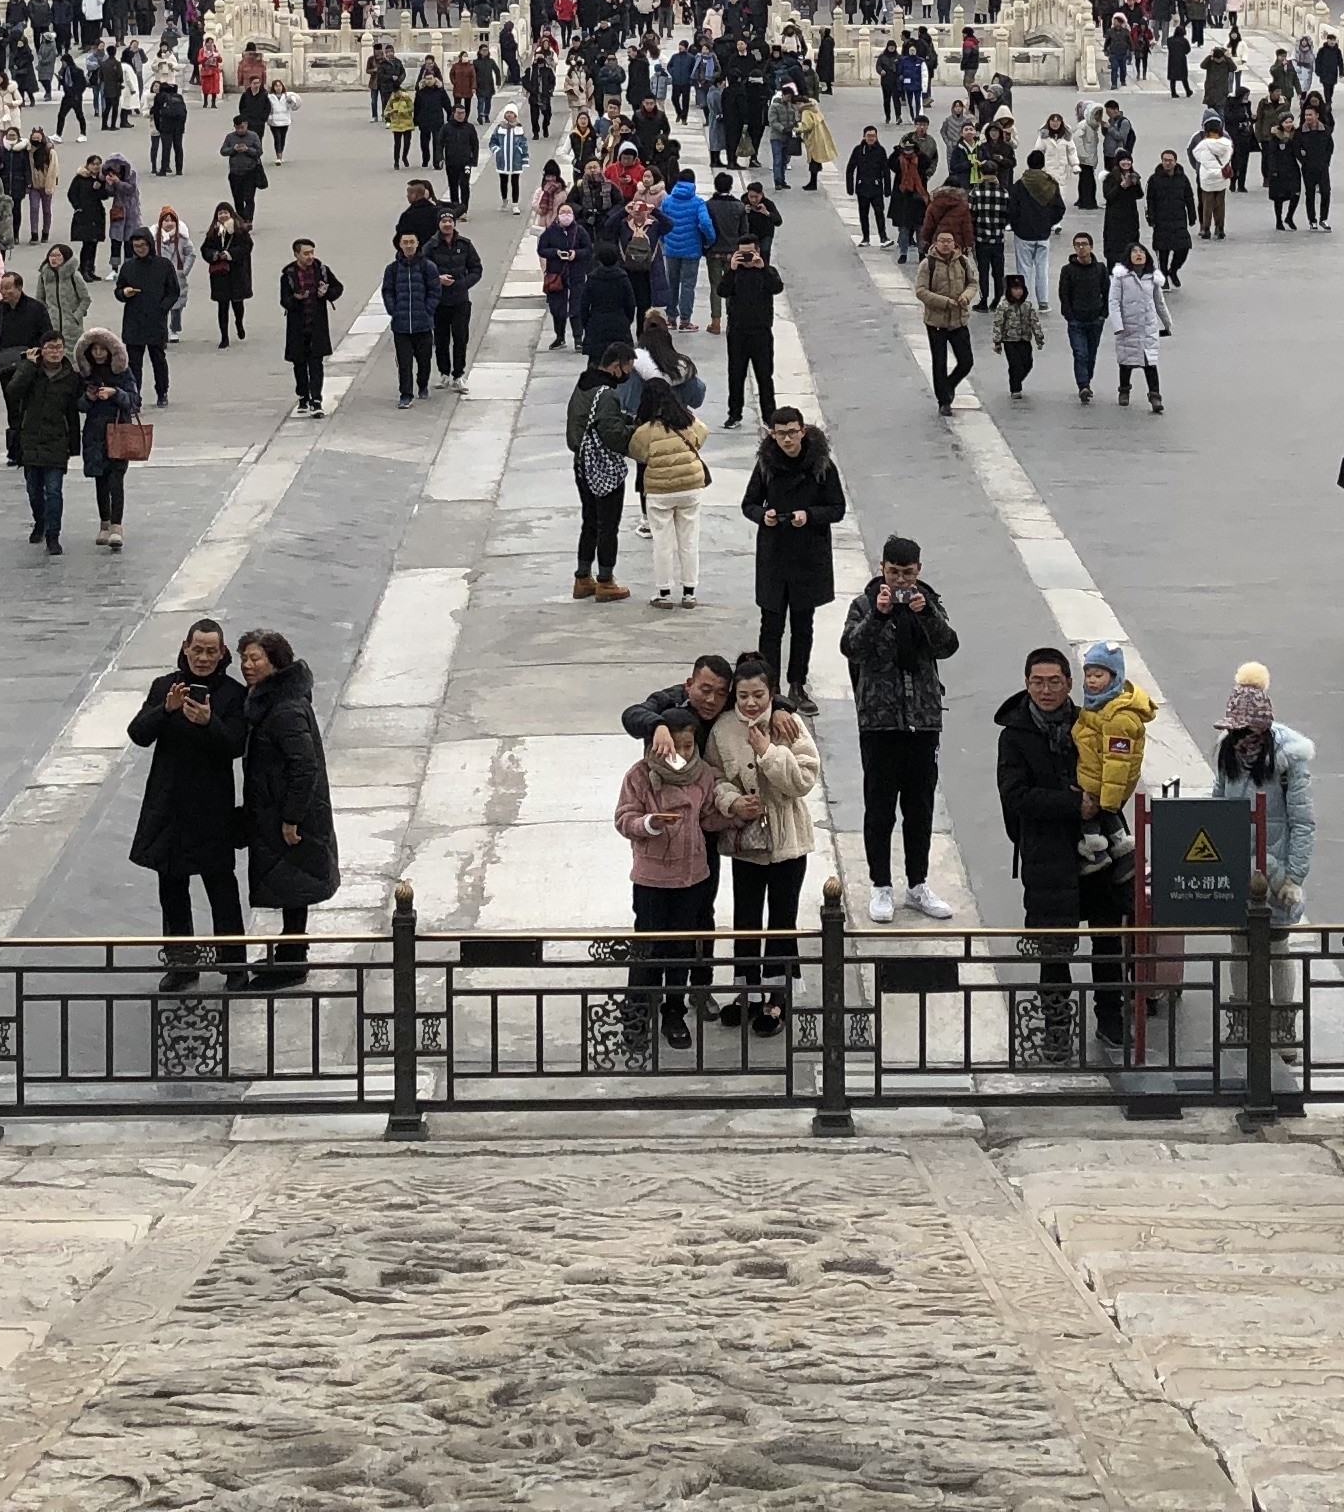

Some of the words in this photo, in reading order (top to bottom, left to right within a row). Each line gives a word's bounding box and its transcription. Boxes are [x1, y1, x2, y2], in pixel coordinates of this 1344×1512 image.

[1173, 875, 1231, 890] 当心滑跌
[1169, 891, 1194, 900] Watch
[1195, 891, 1213, 900] Your
